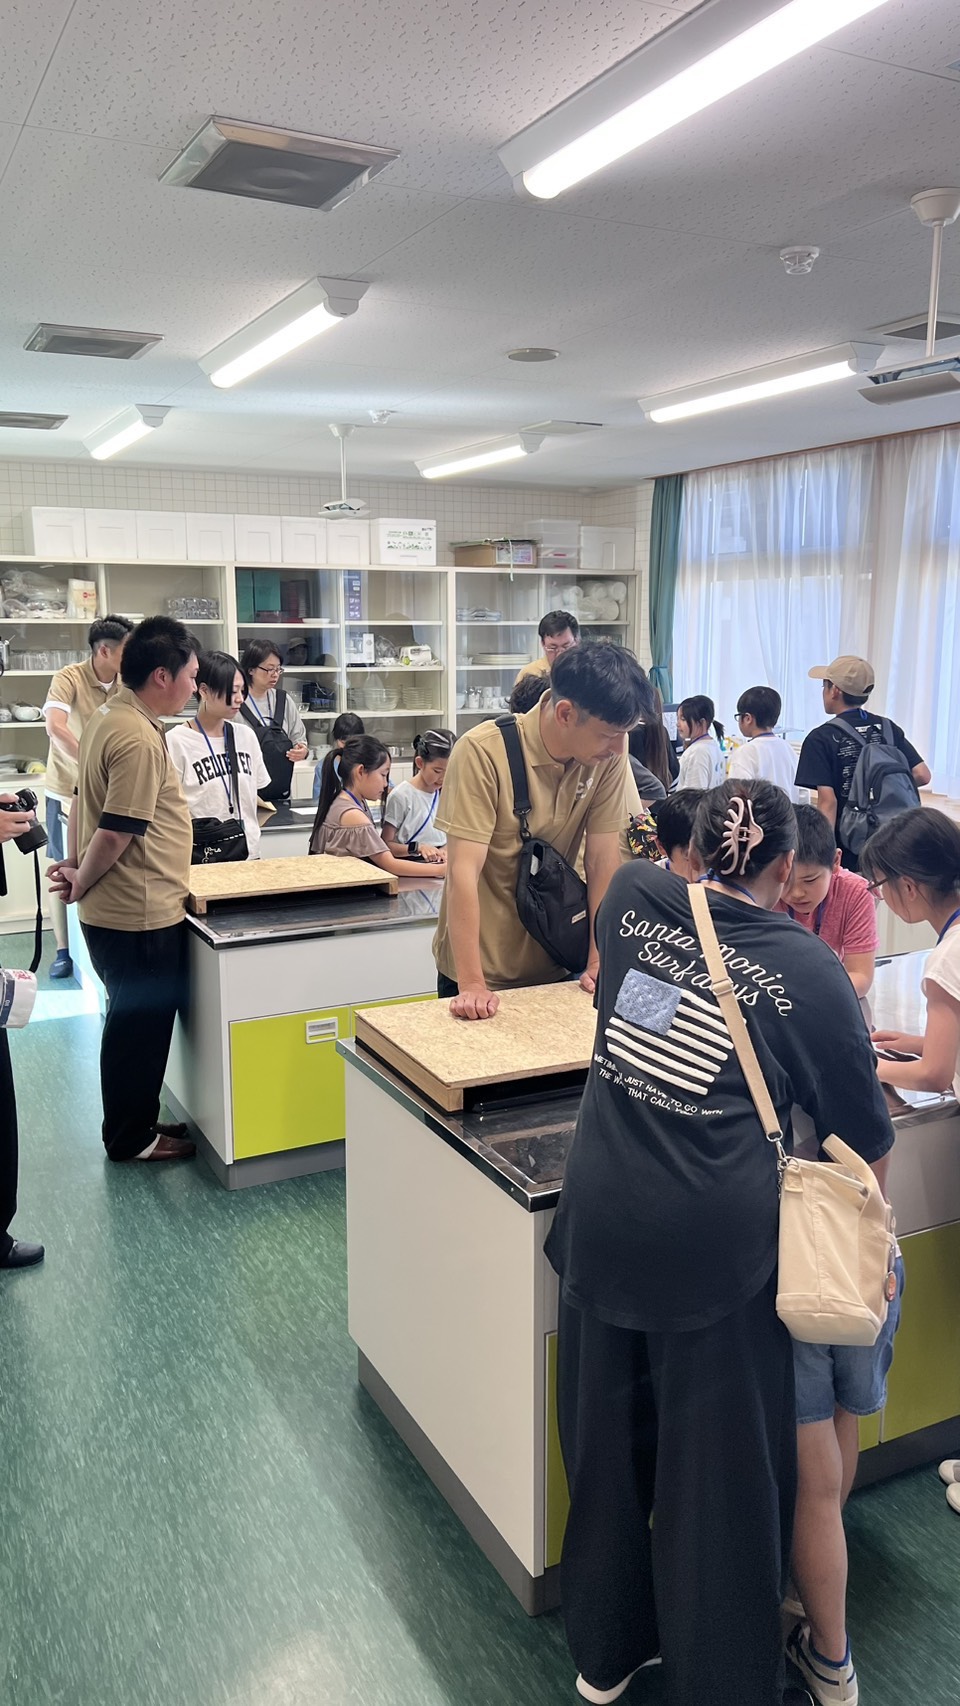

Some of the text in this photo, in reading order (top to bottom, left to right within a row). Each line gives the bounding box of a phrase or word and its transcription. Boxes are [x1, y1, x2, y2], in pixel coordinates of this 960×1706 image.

[192, 752, 252, 786] RELIEED
[619, 910, 697, 951] Santa
[638, 941, 696, 982] Surf
[624, 1076, 645, 1088] JUST
[645, 1084, 668, 1099] HAVE
[670, 1098, 683, 1108] TO
[684, 1104, 698, 1113] GO
[628, 1087, 649, 1101] THAT
[650, 1096, 671, 1110] CALL
